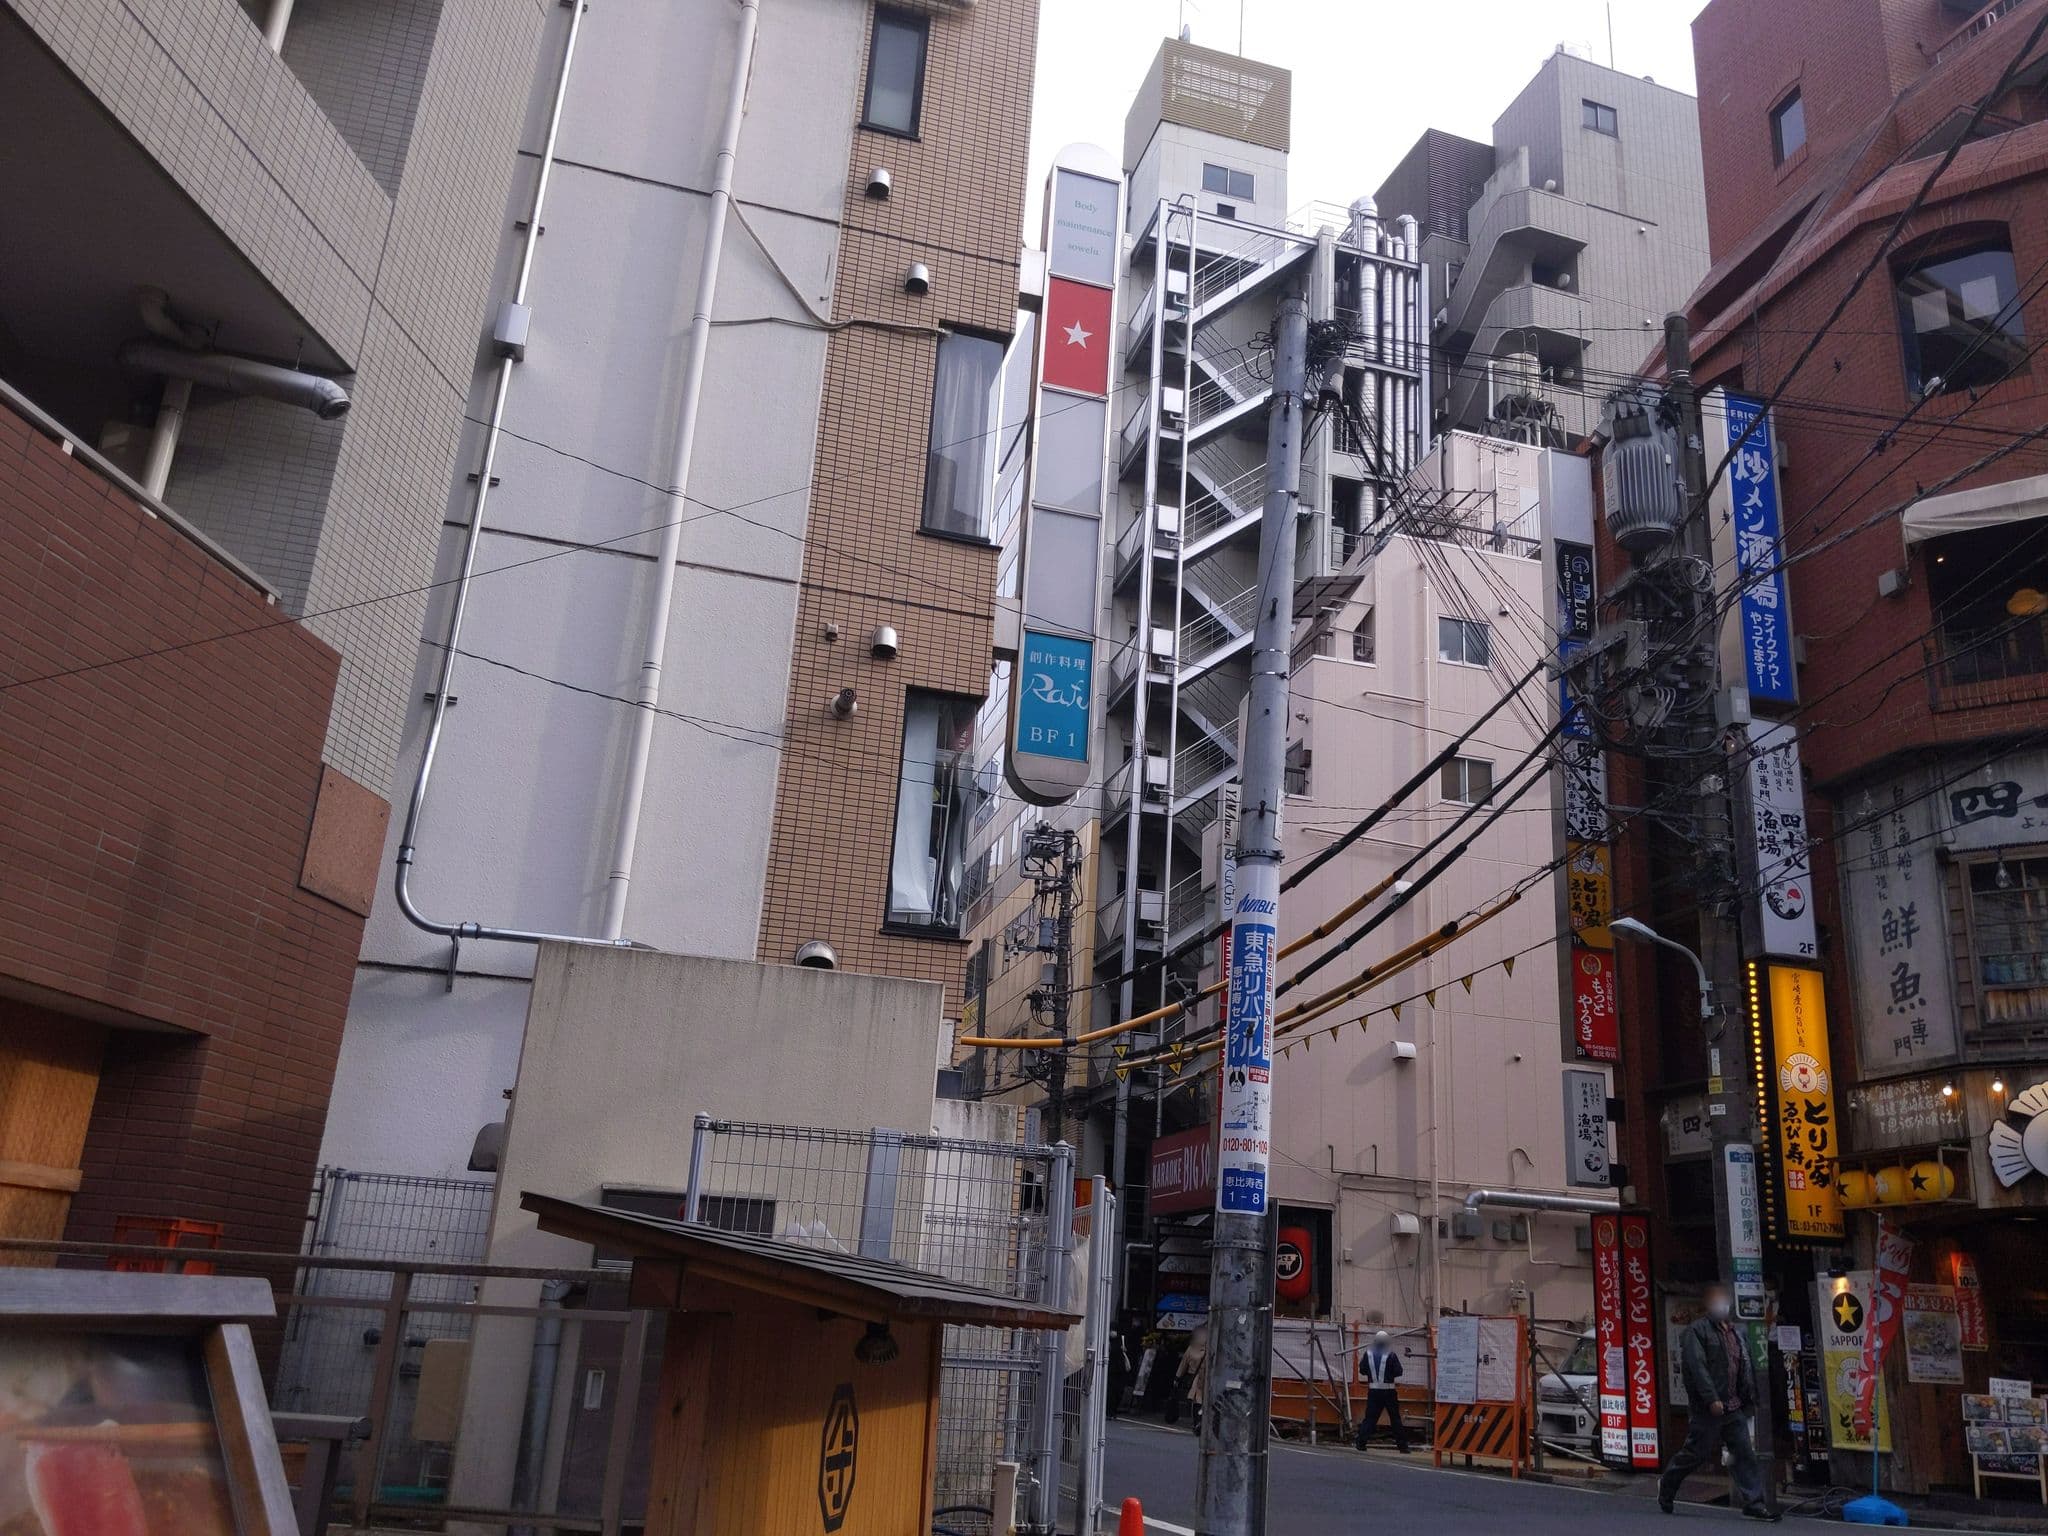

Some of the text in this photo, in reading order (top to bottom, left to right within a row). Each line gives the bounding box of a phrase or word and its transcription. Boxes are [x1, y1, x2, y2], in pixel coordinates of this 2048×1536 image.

[1730, 409, 1765, 423] EBIS
[1030, 651, 1086, 671] 創作料理
[1764, 613, 1781, 690] テイクアウト
[1031, 726, 1059, 744] BF
[1757, 809, 1781, 858] 漁場
[1799, 942, 1815, 954] 2F
[1239, 931, 1265, 1058] 東急リバブル
[1592, 978, 1605, 1017] もっと
[1227, 966, 1243, 1058] 恵比寿センター
[1578, 994, 1593, 1041] やるき
[1578, 1113, 1592, 1142] 漁場
[1592, 1114, 1606, 1149] 四十八
[1782, 1100, 1805, 1166] ゑび寿
[1223, 1138, 1268, 1154] 0120-801-109
[1804, 1098, 1833, 1189] とり家
[1152, 1157, 1182, 1190] KARAOKE
[1183, 1145, 1199, 1193] BIG
[1225, 1176, 1263, 1190] 恵比寿西
[1599, 1174, 1608, 1182] 2F
[1808, 1205, 1822, 1217] 1F
[1629, 1257, 1651, 1414] もっとやるき
[1831, 1335, 1864, 1346] SAPPO
[1607, 1415, 1622, 1427] B1F
[1638, 1444, 1653, 1454] B1F
